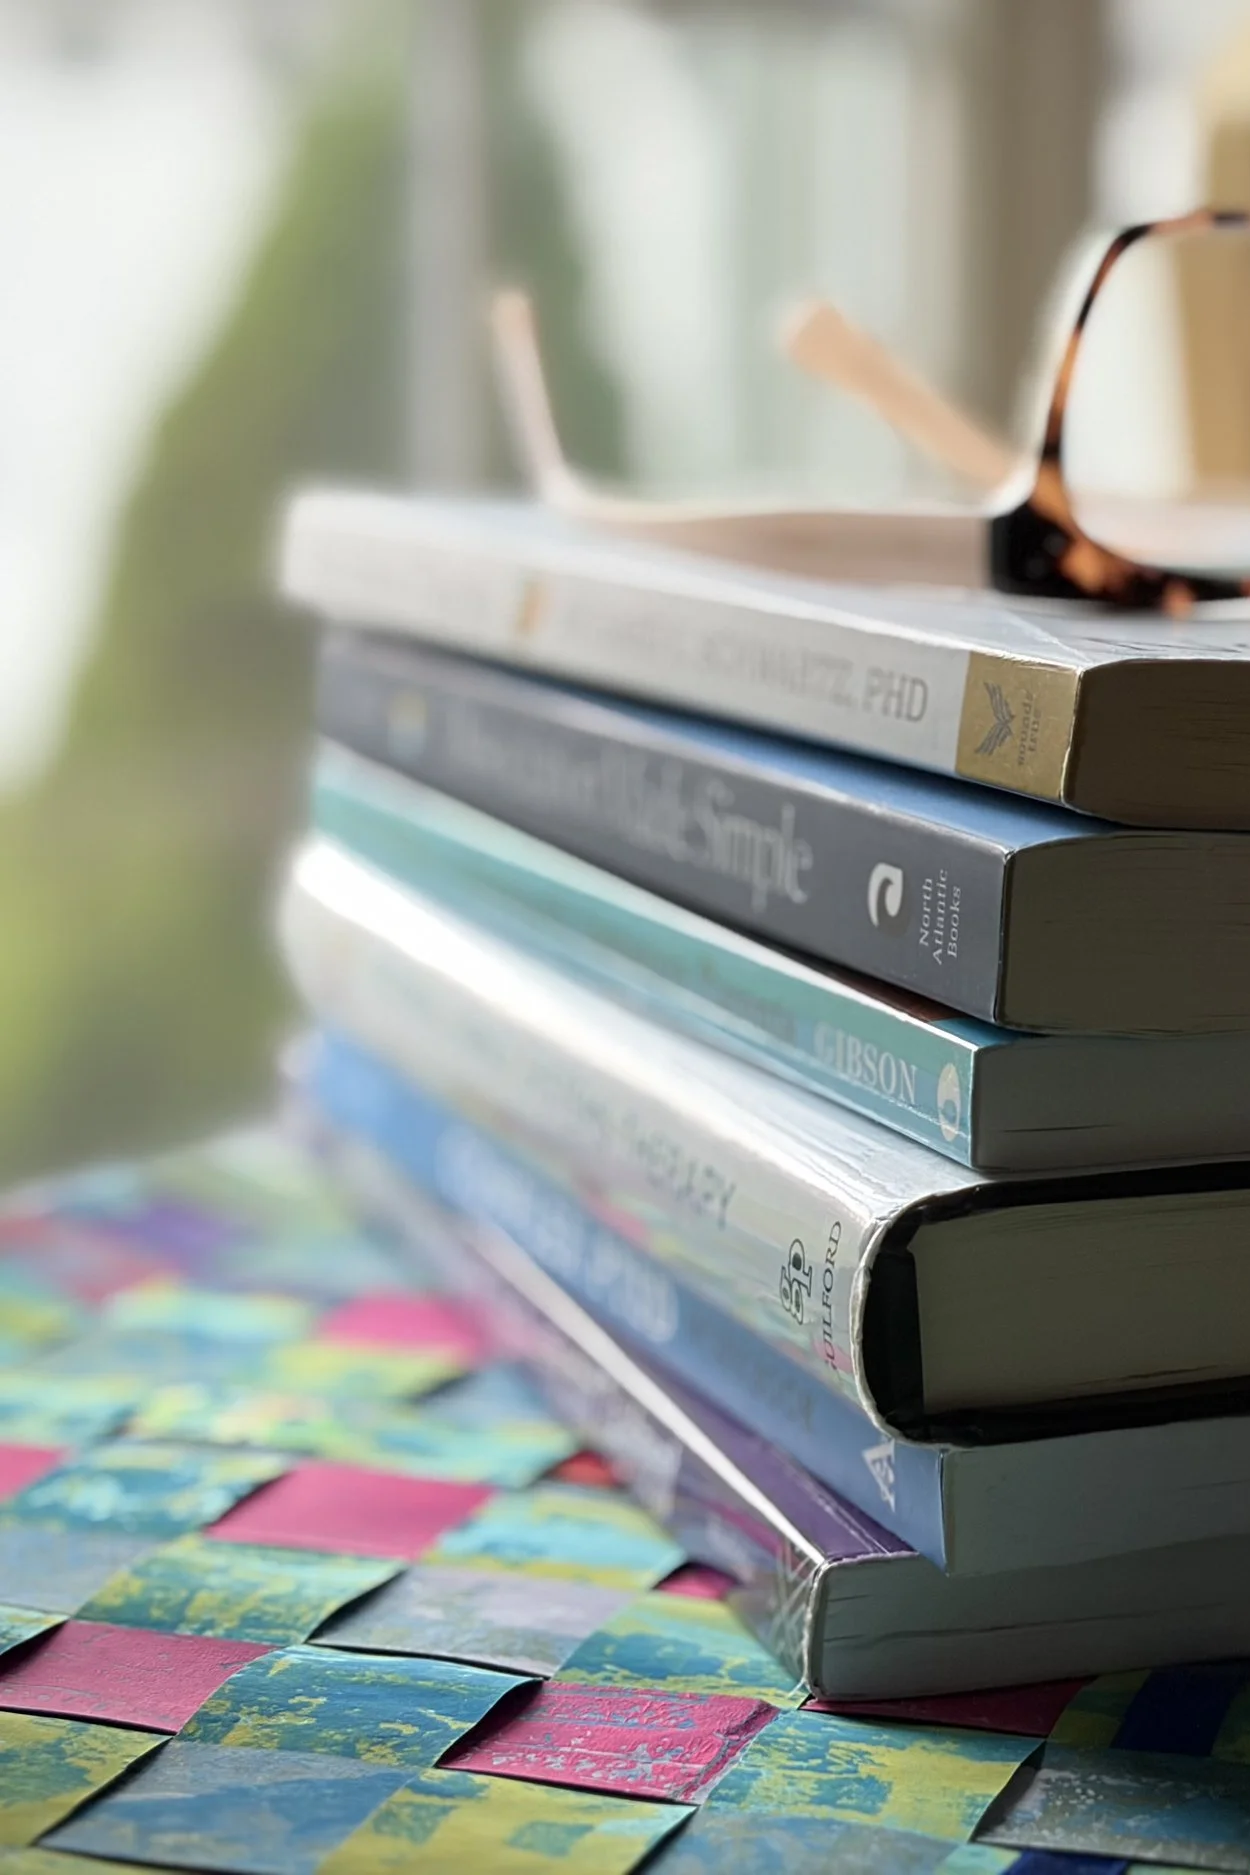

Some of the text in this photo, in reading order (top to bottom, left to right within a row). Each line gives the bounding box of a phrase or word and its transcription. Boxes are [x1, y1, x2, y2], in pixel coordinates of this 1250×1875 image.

[861, 666, 929, 723] PHD
[694, 778, 813, 914] Simple
[919, 877, 933, 946] North
[933, 868, 948, 966] Atlantic
[947, 886, 961, 958] Books
[813, 1021, 918, 1105] GIBSON
